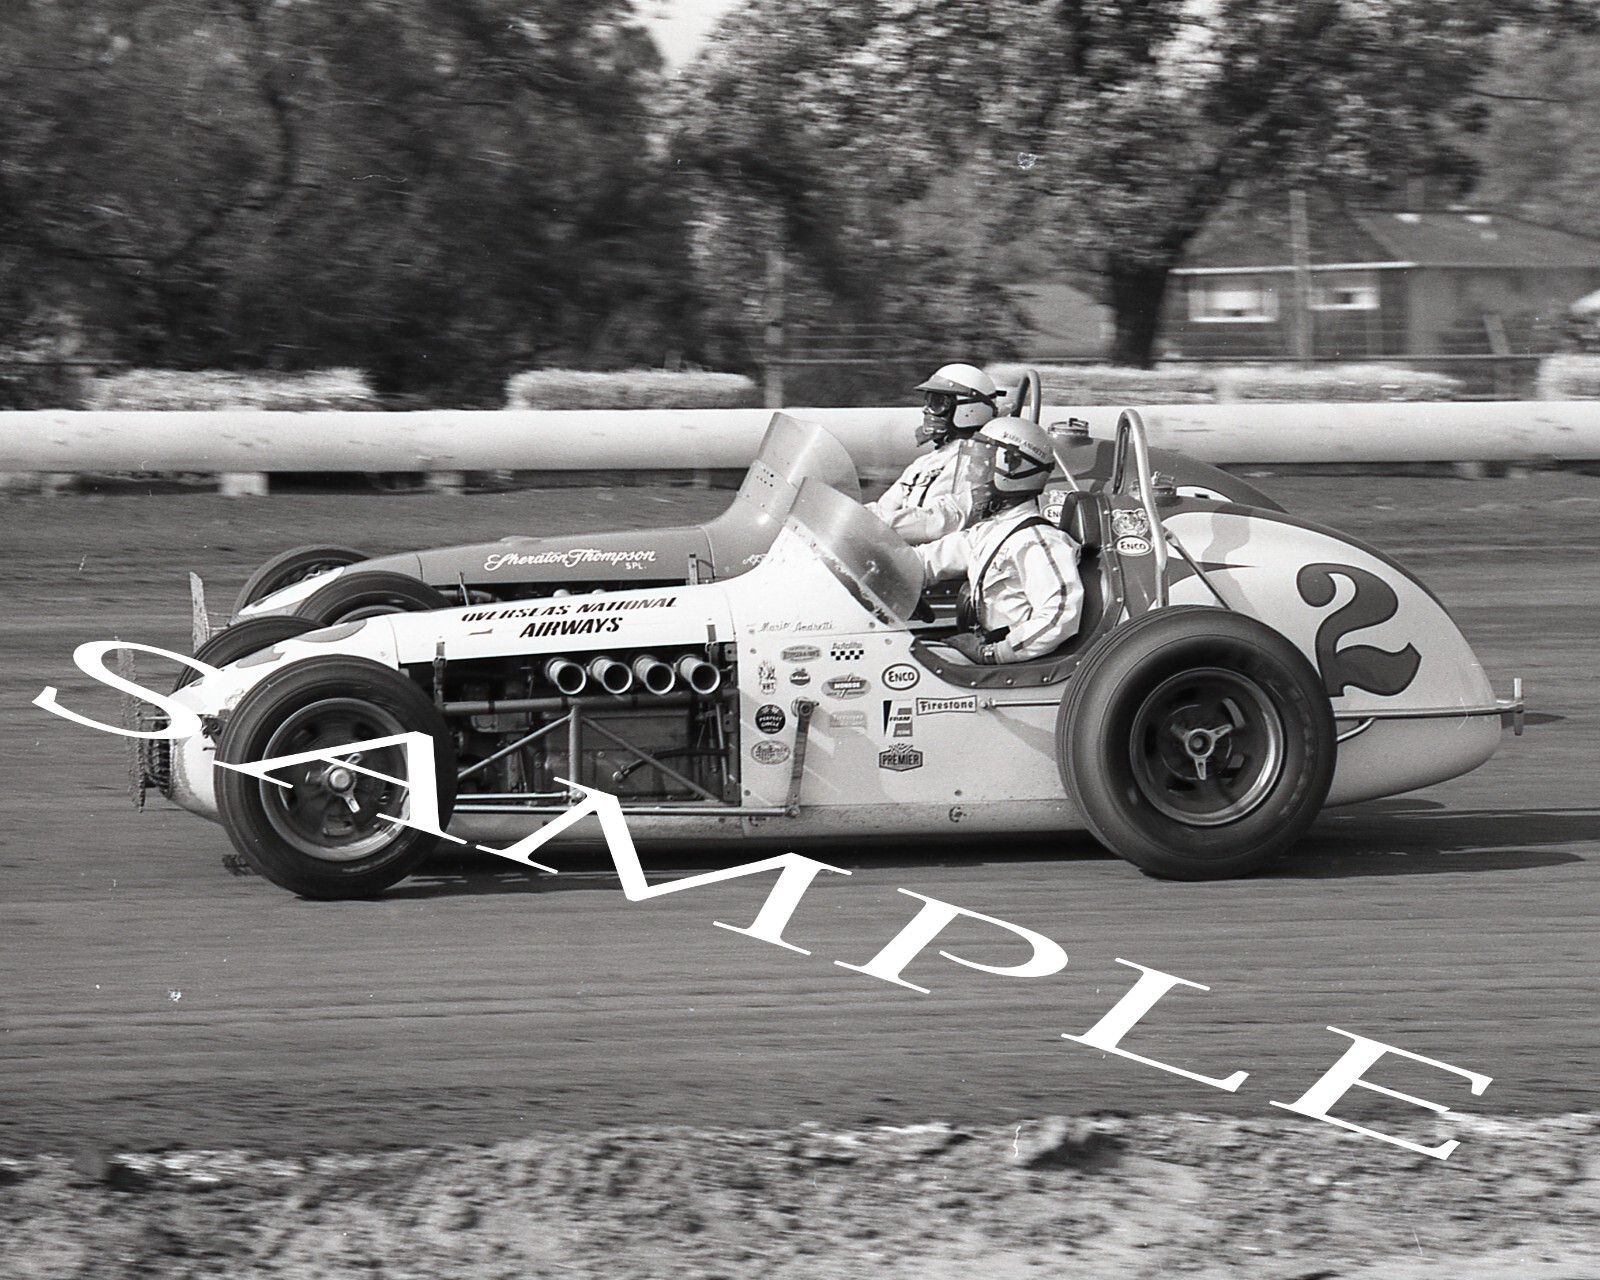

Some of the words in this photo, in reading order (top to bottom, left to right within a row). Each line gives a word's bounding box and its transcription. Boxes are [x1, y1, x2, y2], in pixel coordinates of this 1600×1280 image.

[1120, 541, 1147, 550] ENCO
[461, 605, 572, 622] OVERSEAS
[576, 597, 678, 613] NATIONAL
[519, 617, 623, 638] AIRWAYS
[1296, 562, 1422, 698] 2
[888, 670, 915, 683] ENCO
[919, 700, 975, 711] Firestone
[882, 754, 920, 766] PREMIER
